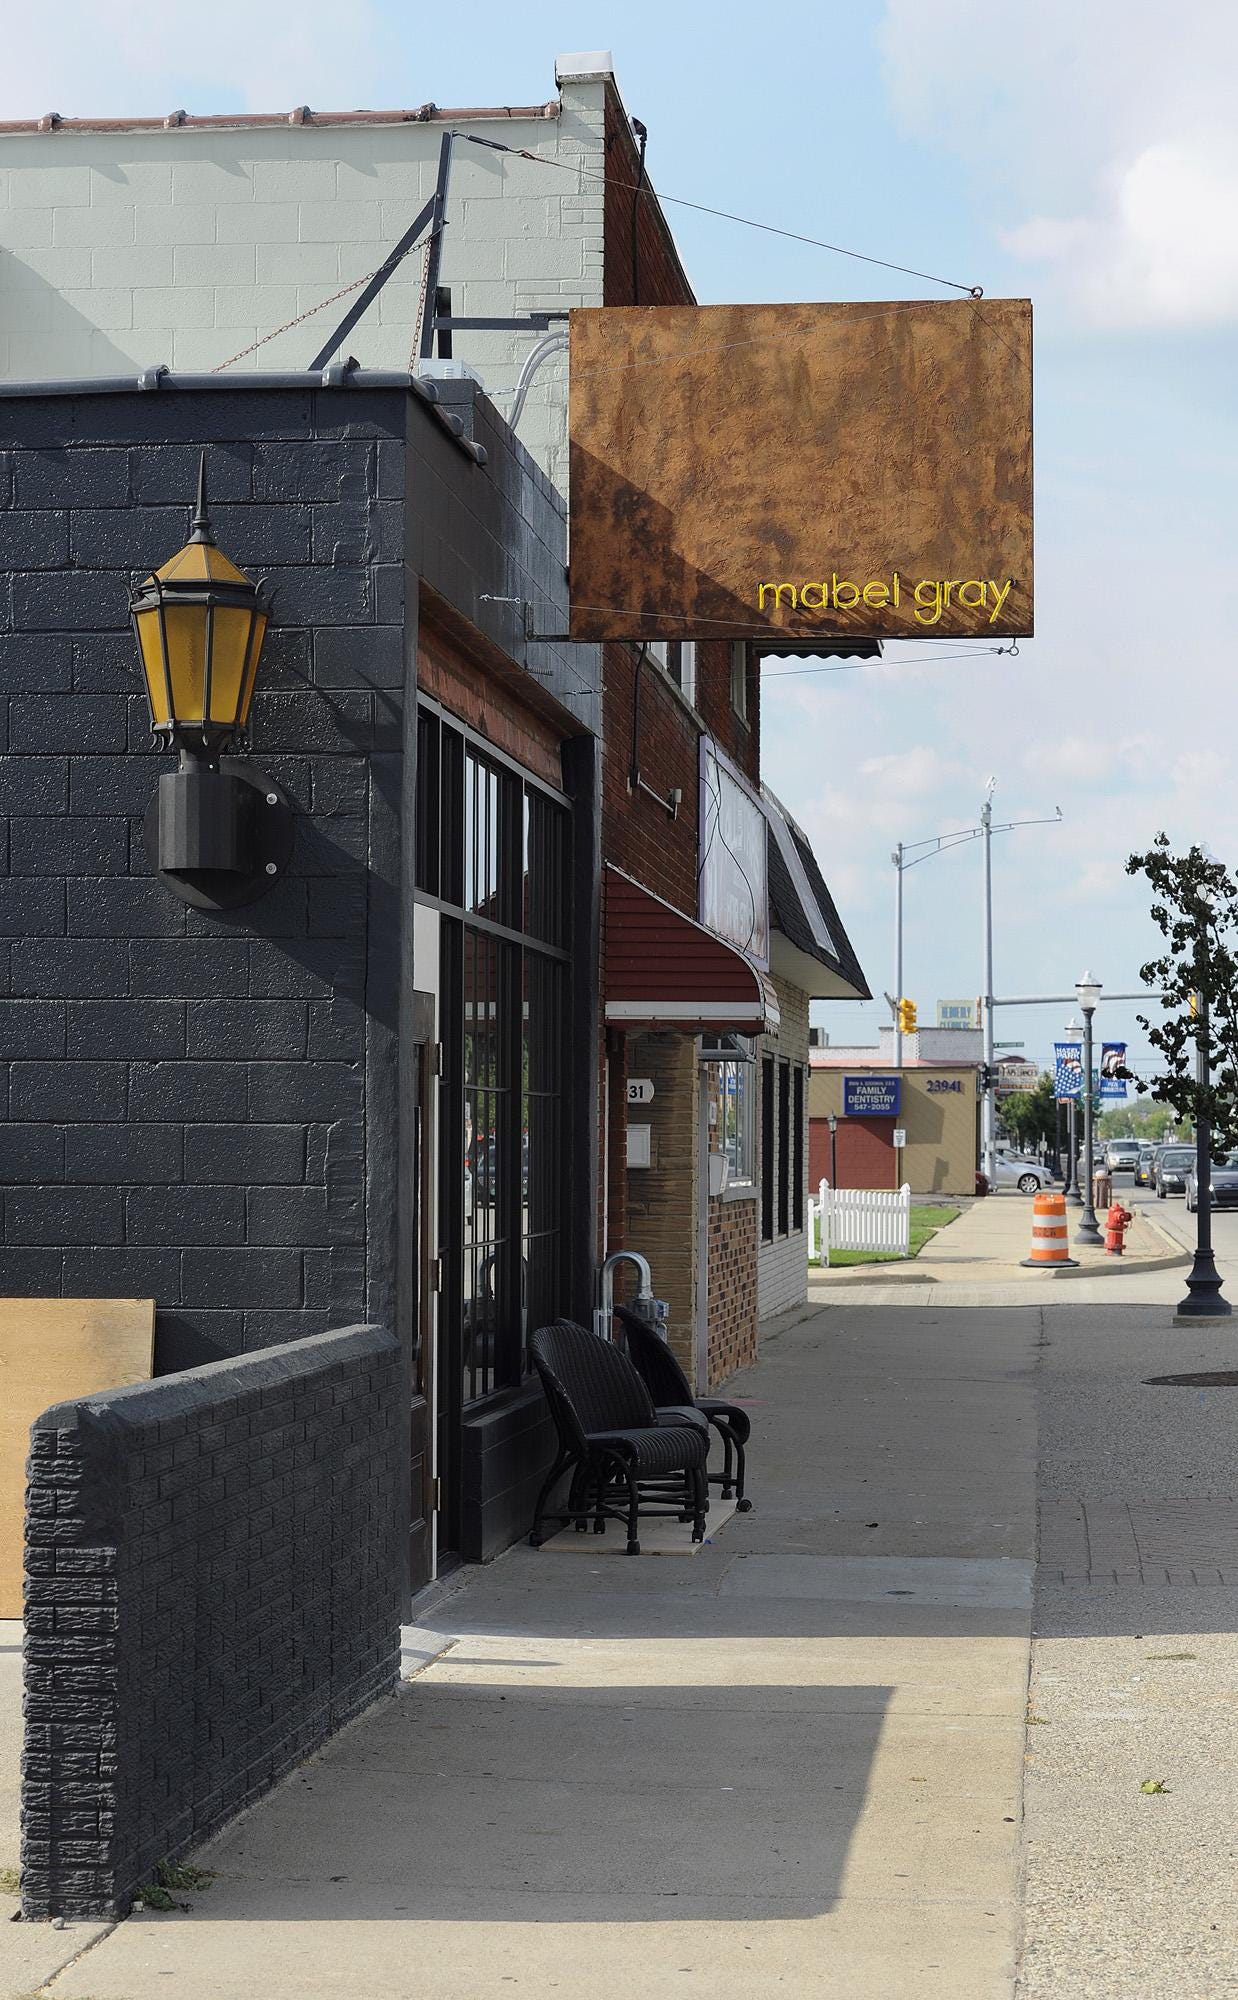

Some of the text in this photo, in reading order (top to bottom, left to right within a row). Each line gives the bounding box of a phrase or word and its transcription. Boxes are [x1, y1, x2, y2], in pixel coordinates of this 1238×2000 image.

[758, 571, 1014, 625] mabel gray
[856, 1086, 887, 1094] FAMILY
[926, 1079, 962, 1092] 23941
[848, 1094, 896, 1103] DENTISTRY
[854, 1103, 890, 1111] 547-2055
